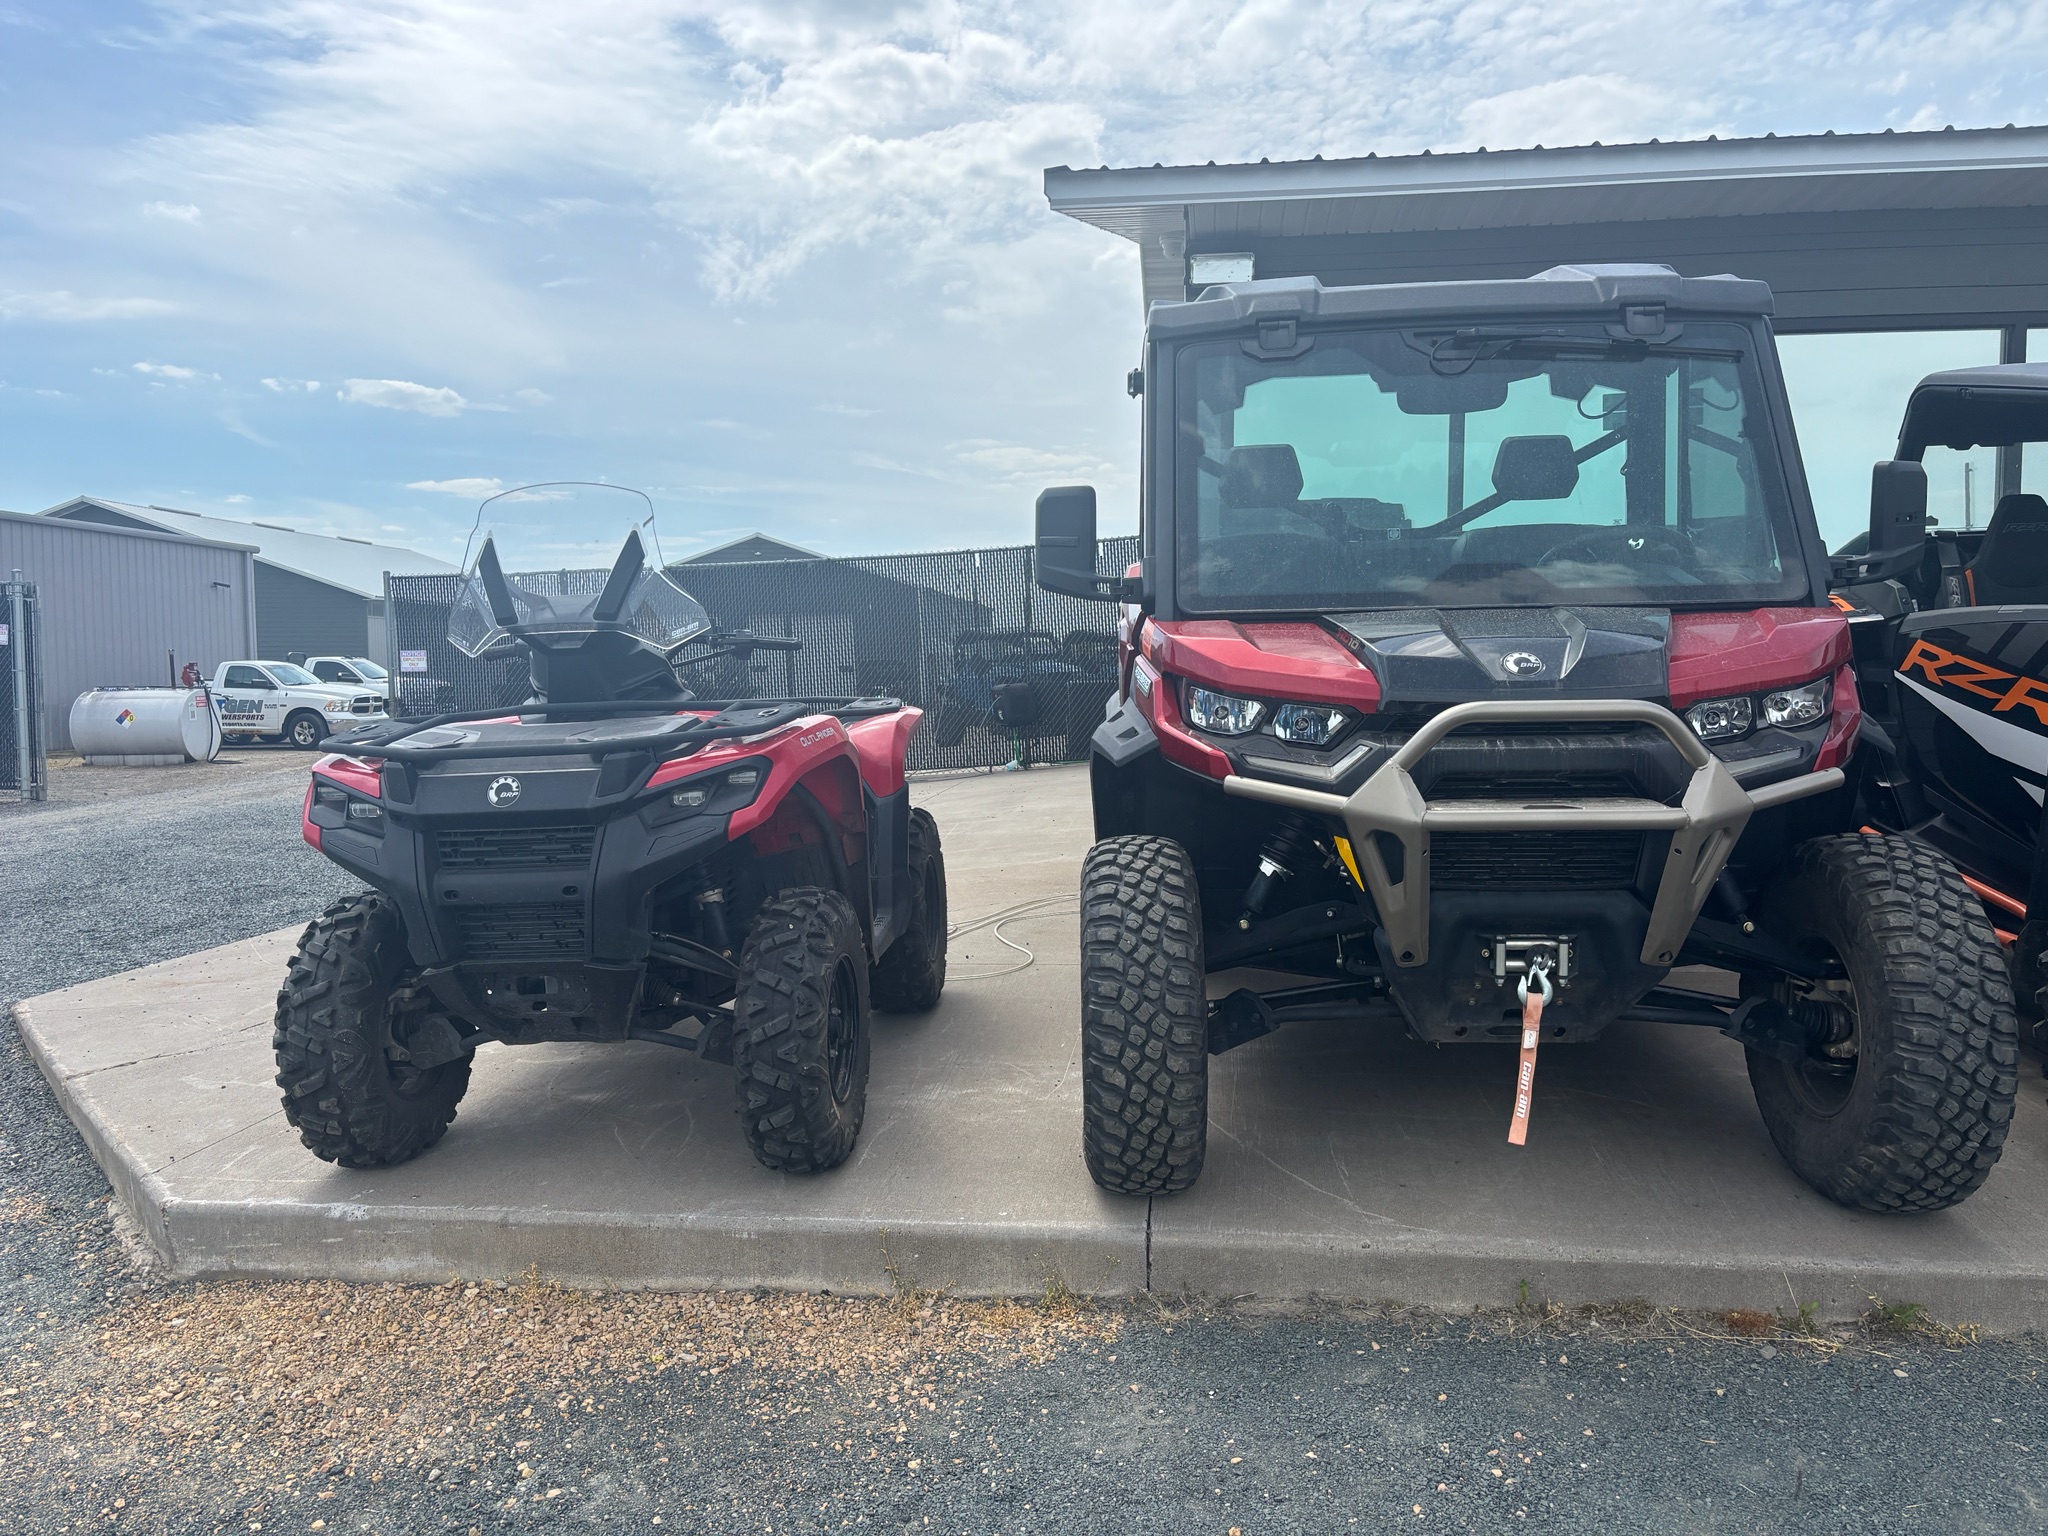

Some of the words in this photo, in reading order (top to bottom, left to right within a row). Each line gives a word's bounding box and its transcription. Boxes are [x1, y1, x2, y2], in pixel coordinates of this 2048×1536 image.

[1949, 576, 1961, 604] RZR
[1899, 639, 2048, 726] RZR
[800, 727, 834, 747] OUTLANDER
[1516, 1061, 1532, 1118] can-am
